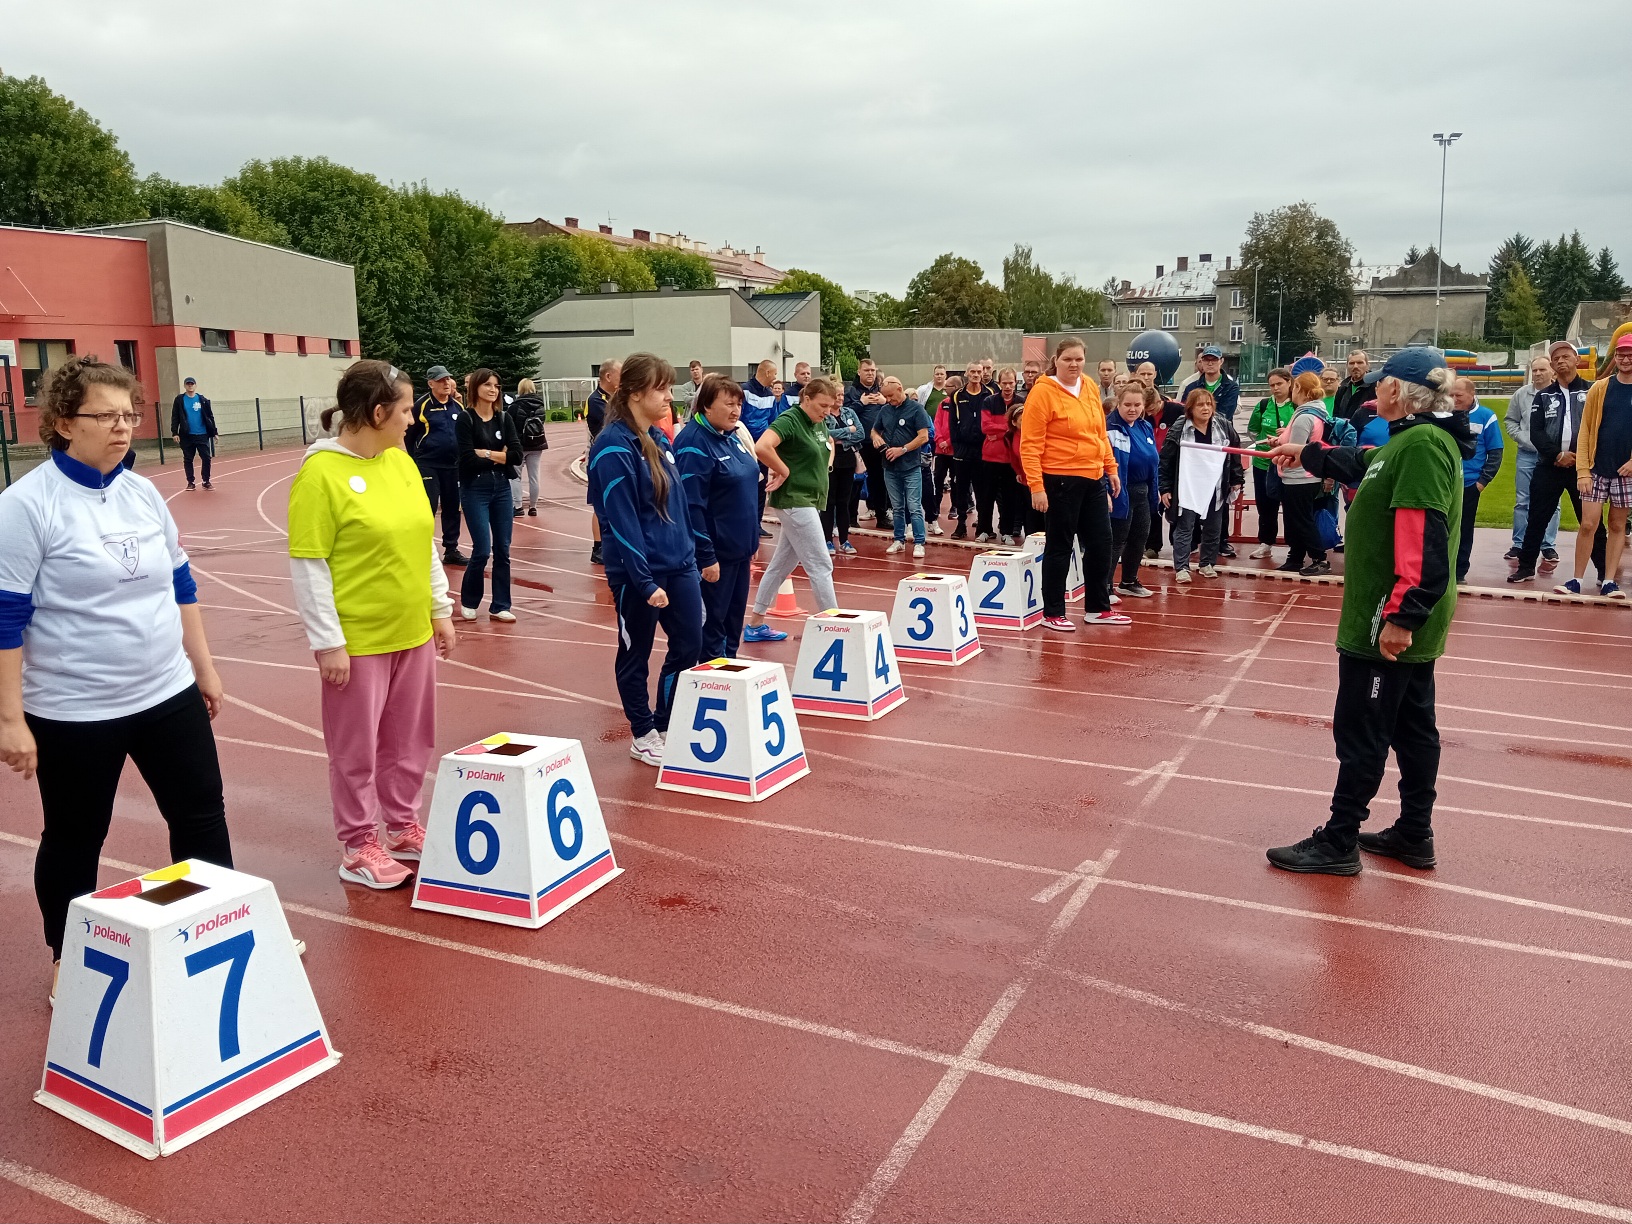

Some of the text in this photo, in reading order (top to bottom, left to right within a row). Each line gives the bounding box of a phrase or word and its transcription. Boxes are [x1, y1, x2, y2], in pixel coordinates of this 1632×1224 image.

[979, 570, 1006, 610] 2
[1024, 569, 1037, 609] 2
[823, 625, 851, 633] polanik
[907, 597, 934, 641] 3
[955, 594, 968, 638] 3
[813, 638, 848, 692] 4
[874, 633, 890, 685] 4
[700, 681, 732, 692] polanik
[689, 696, 728, 763] 5
[761, 689, 785, 757] 5
[466, 768, 506, 783] polanik
[545, 753, 572, 777] polanik
[455, 790, 501, 876] 6
[547, 778, 583, 861] 6
[93, 924, 131, 948] polanik
[195, 903, 251, 940] polanik
[83, 946, 130, 1069] 7
[184, 929, 256, 1063] 7
